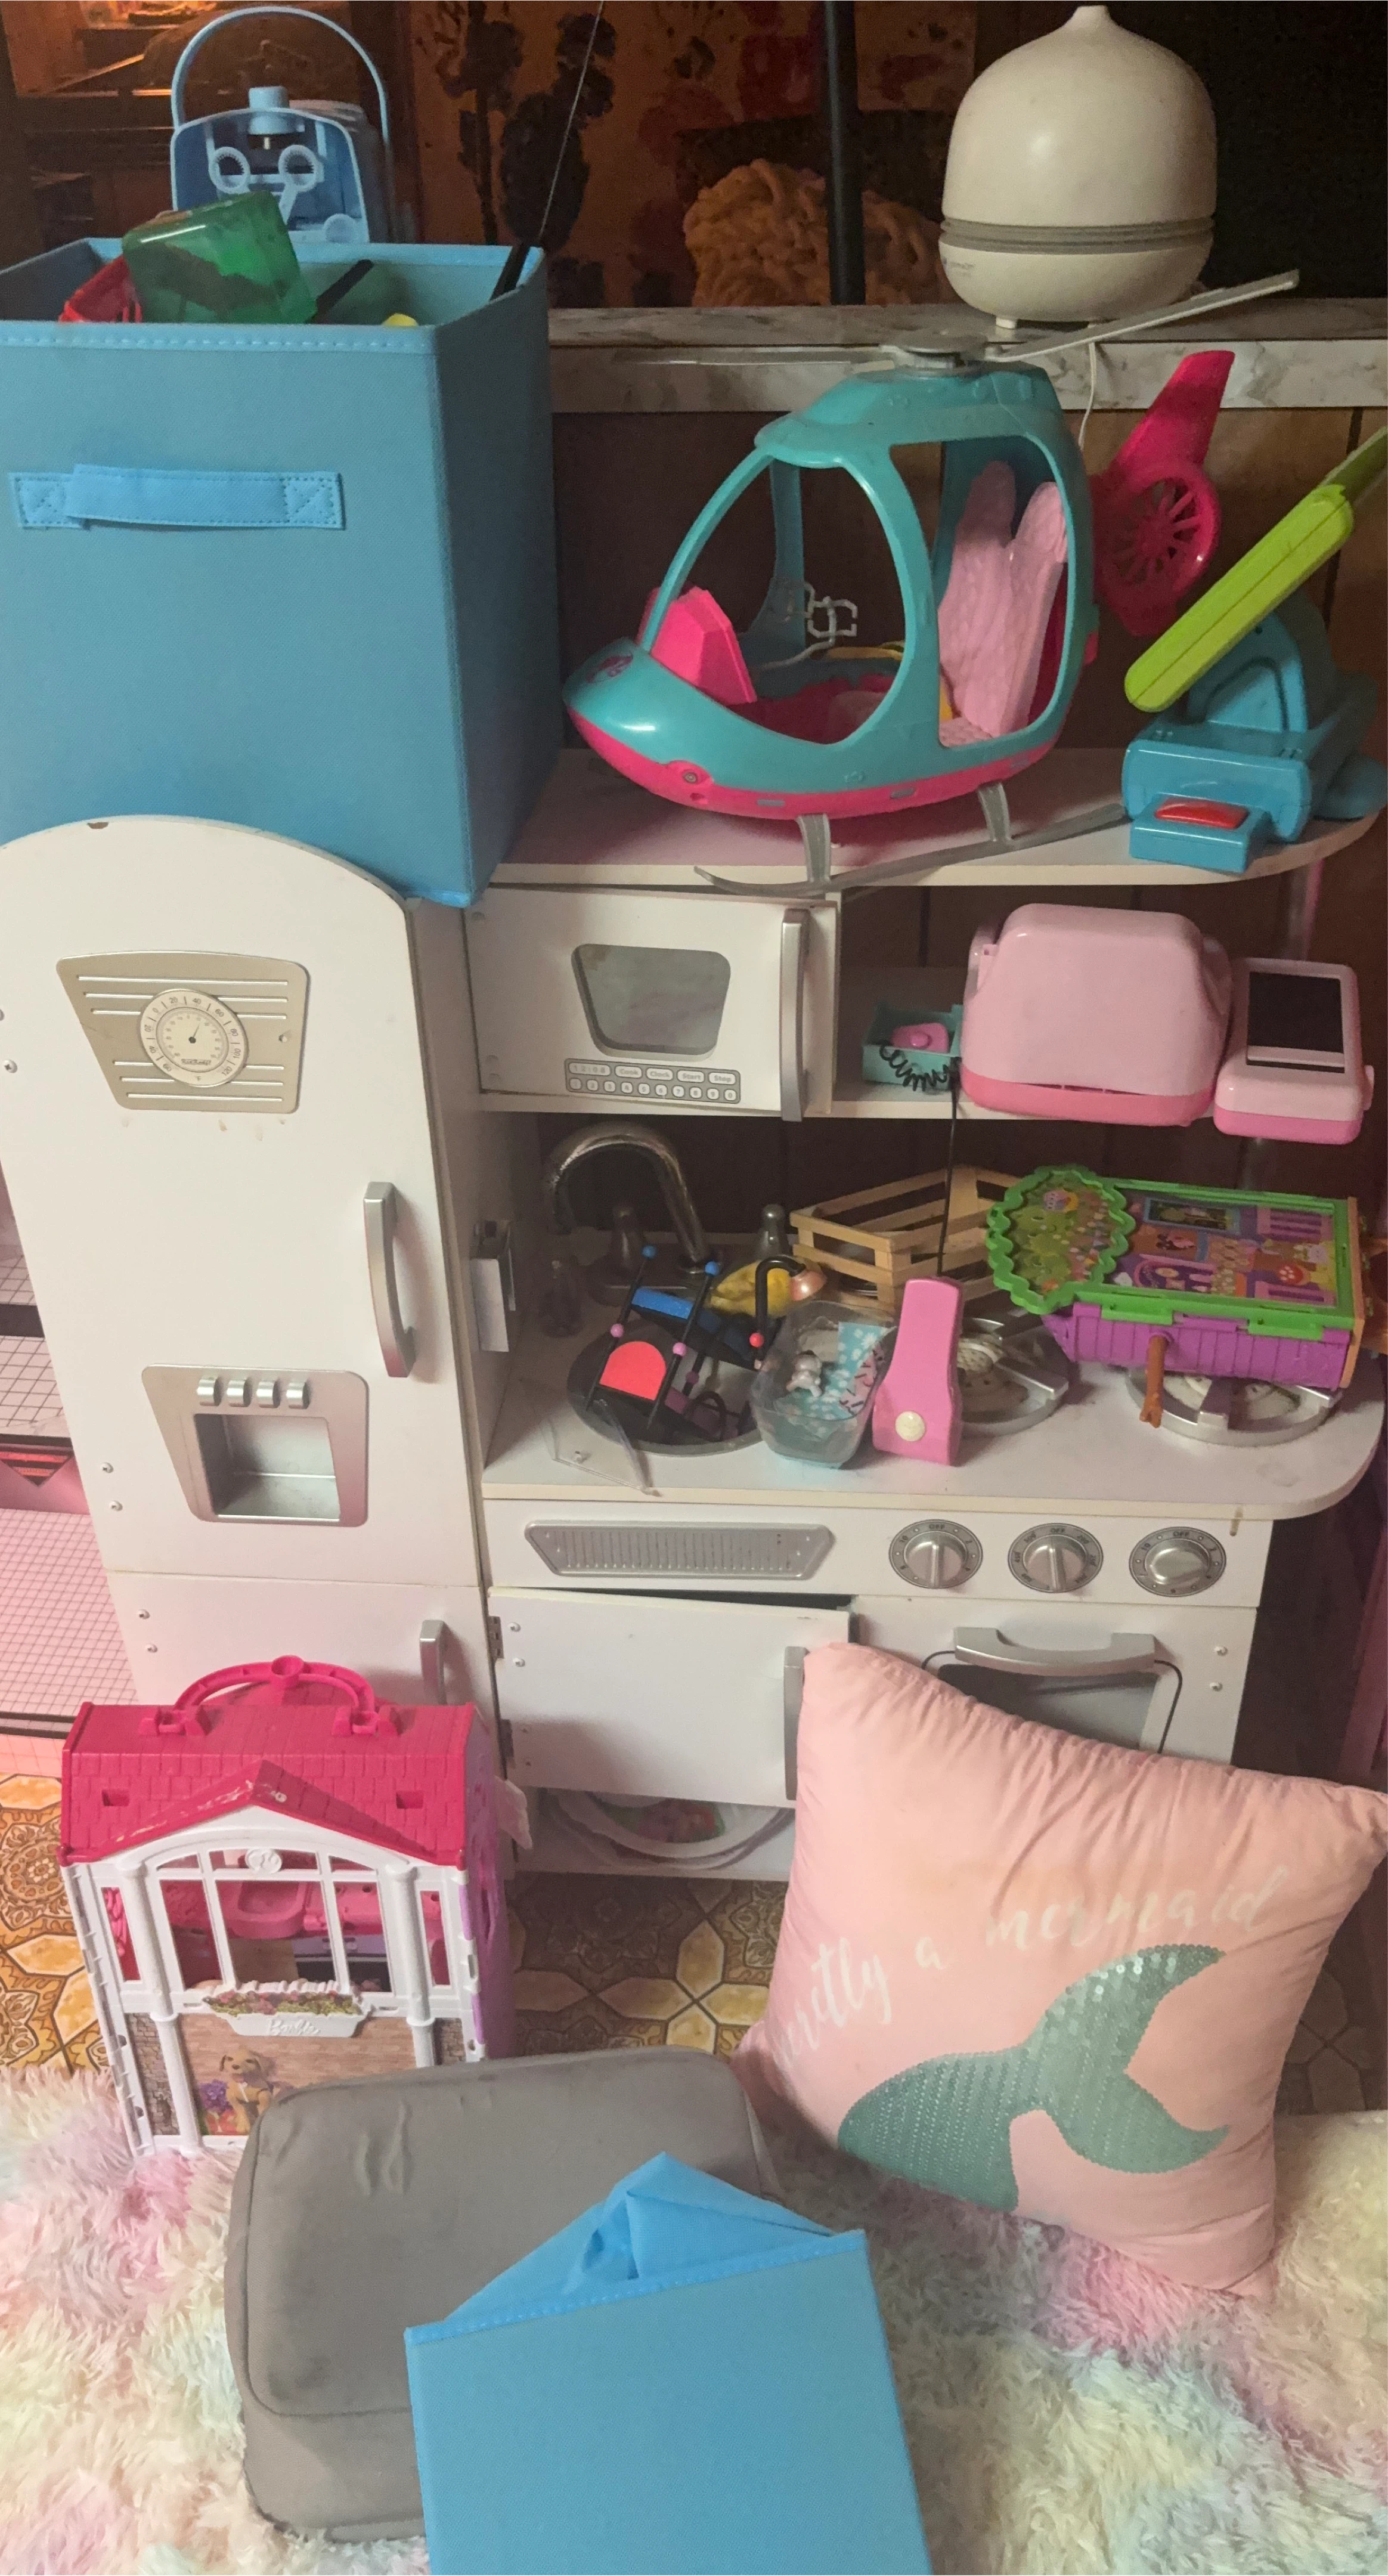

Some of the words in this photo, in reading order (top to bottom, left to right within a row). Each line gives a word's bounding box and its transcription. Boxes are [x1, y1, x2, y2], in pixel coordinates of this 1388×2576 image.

[215, 1008, 224, 1017] 60
[233, 1048, 241, 1059] 100
[221, 1066, 233, 1076] 120
[915, 1937, 948, 1970] a
[986, 1865, 1288, 1951] mermaid
